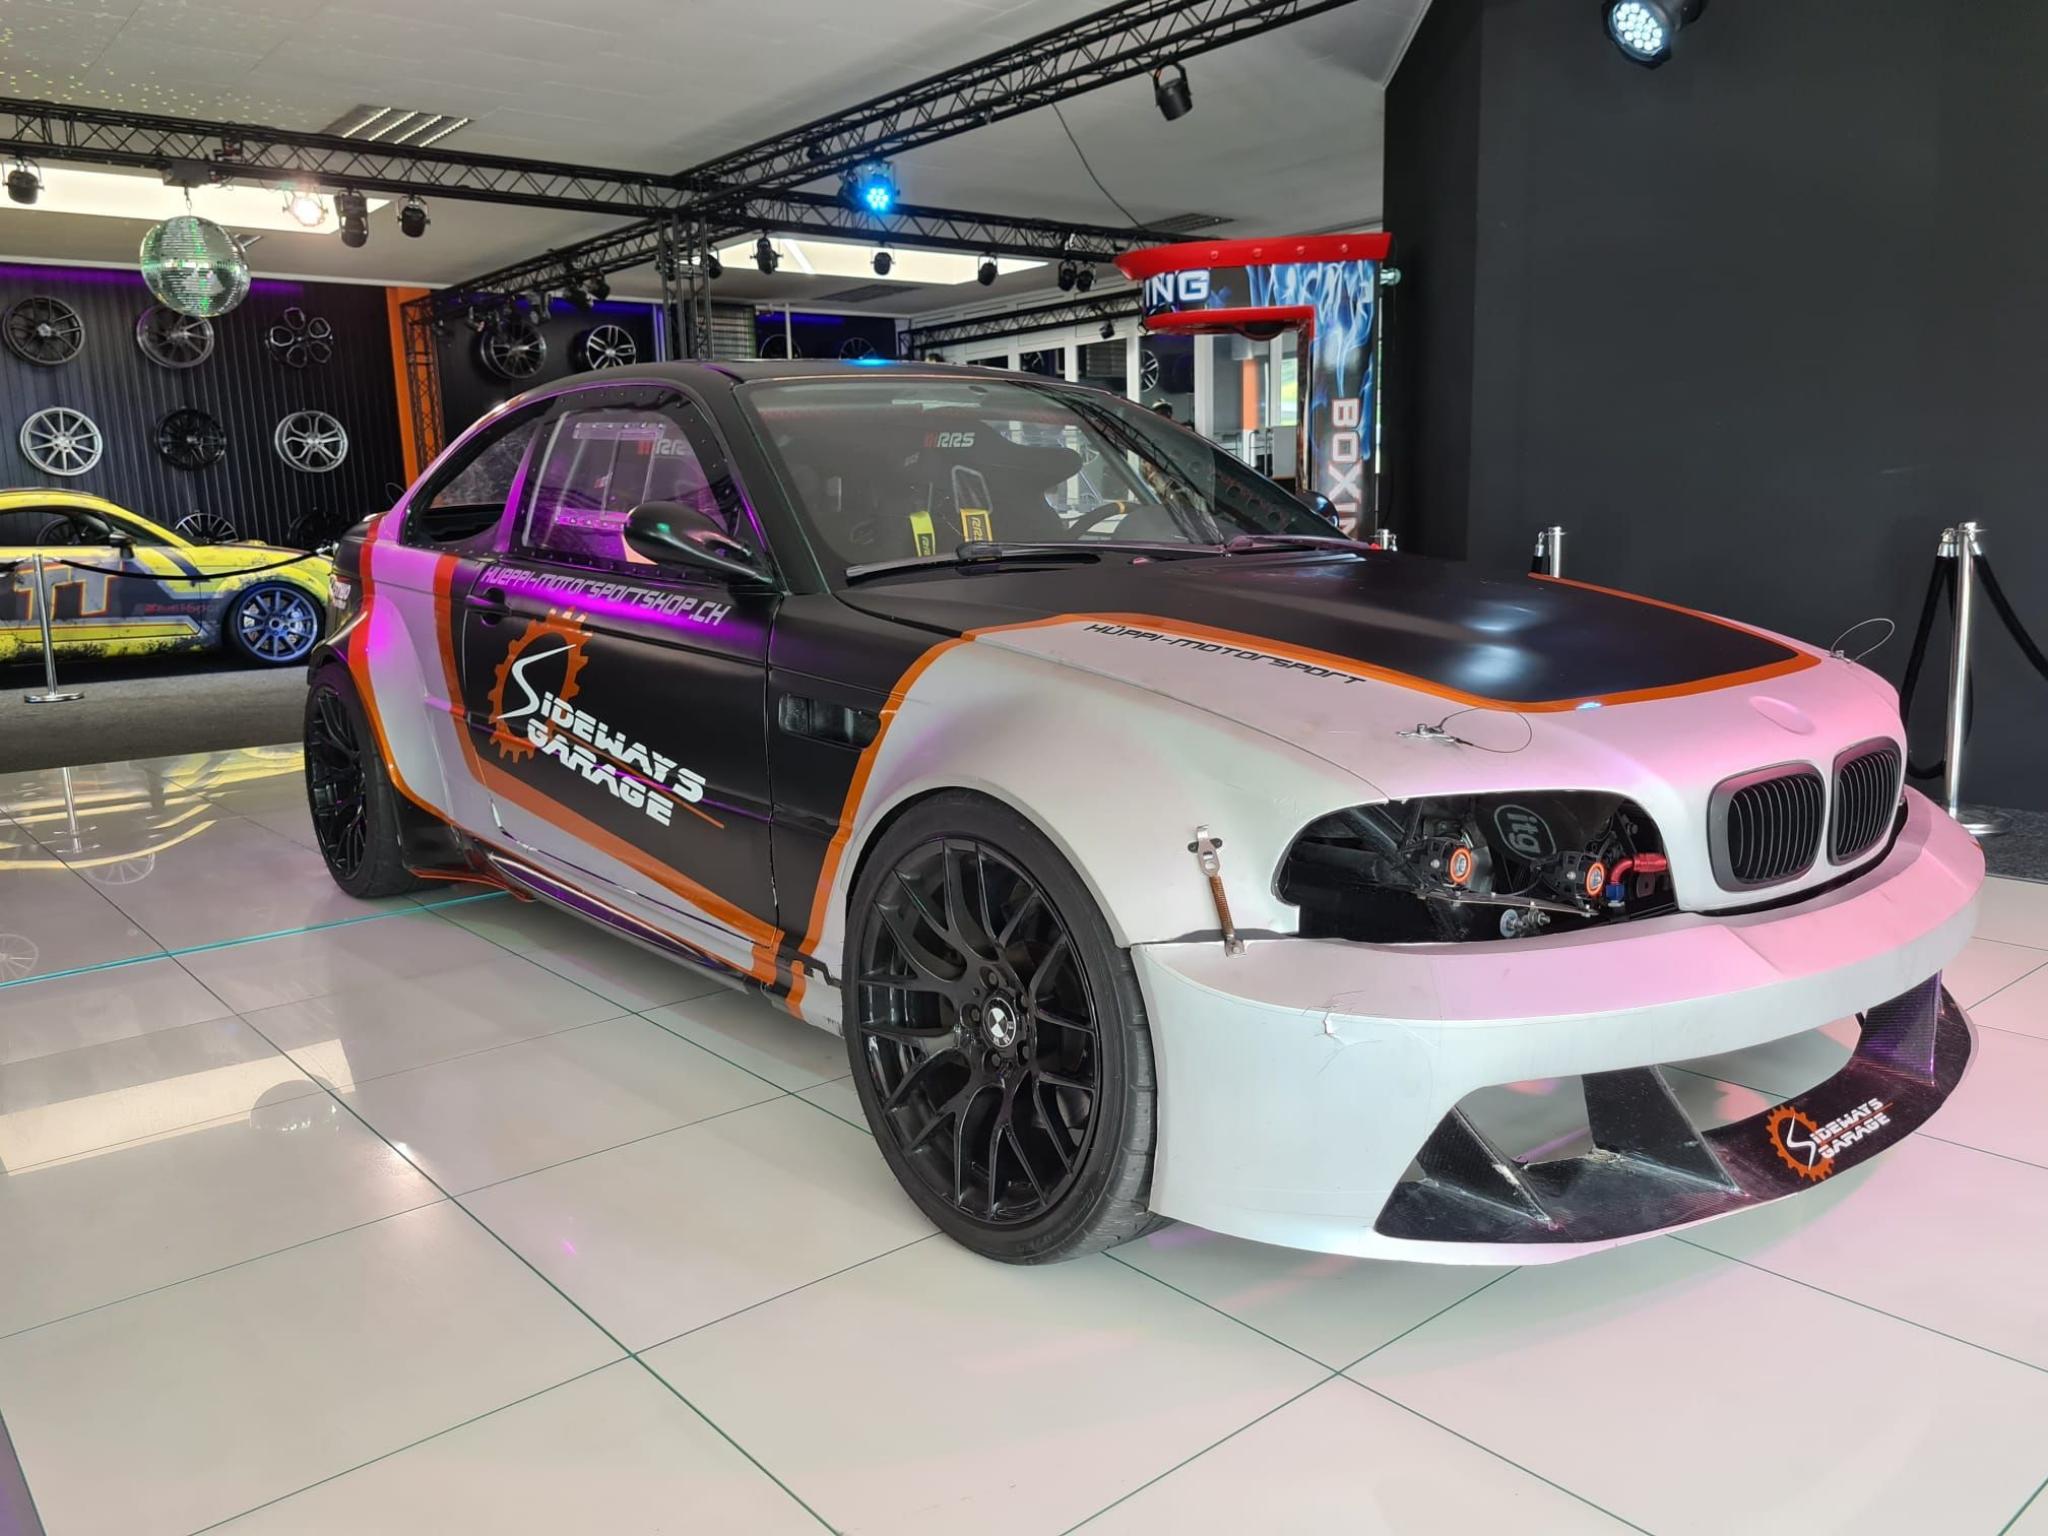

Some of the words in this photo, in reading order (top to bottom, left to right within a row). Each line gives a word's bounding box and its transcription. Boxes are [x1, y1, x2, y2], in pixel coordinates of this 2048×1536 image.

[1145, 269, 1210, 307] ING
[937, 432, 975, 448] RRS
[527, 717, 674, 827] GARAGE
[1818, 1112, 1891, 1159] GARAGE
